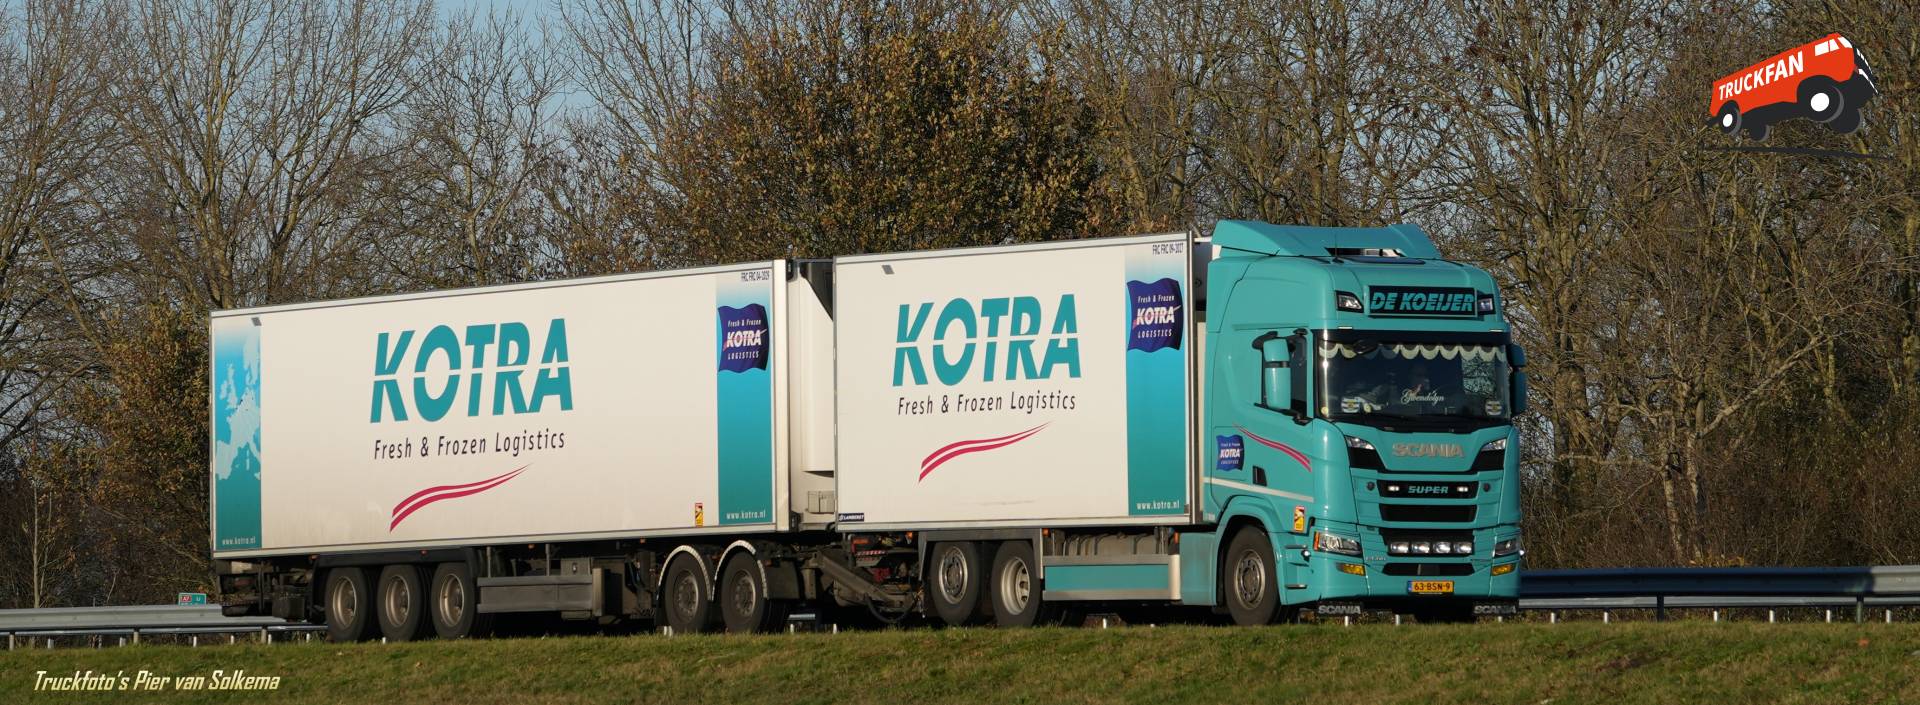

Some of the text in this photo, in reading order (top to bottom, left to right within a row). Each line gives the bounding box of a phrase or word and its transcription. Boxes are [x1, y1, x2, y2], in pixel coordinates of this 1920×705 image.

[1138, 295, 1175, 304] Fresh & Frozen
[1370, 292, 1475, 311] DE KOEIJER
[1136, 306, 1175, 326] KOTRA
[728, 320, 740, 328] Fresh
[746, 319, 762, 327] Frozen
[727, 329, 762, 348] KOTRA
[1138, 328, 1172, 339] LOGISTICS
[892, 294, 1081, 387] KOTRA
[728, 351, 760, 361] LOGISTICS
[370, 318, 573, 424] KOTRA
[898, 390, 1076, 415] Fresh & Frozen Logistics
[374, 428, 566, 460] Fresh & Frozen Logistics
[1220, 448, 1241, 459] KOTRA
[1392, 443, 1465, 457] SCANIA
[1408, 485, 1449, 494] SUPER
[1136, 500, 1180, 510] www.kotra.nl
[726, 510, 766, 519] www.kotra.nl
[1414, 582, 1451, 591] 63-BSN-9
[1318, 605, 1361, 614] SCANIA
[1474, 605, 1517, 614] SCANIA
